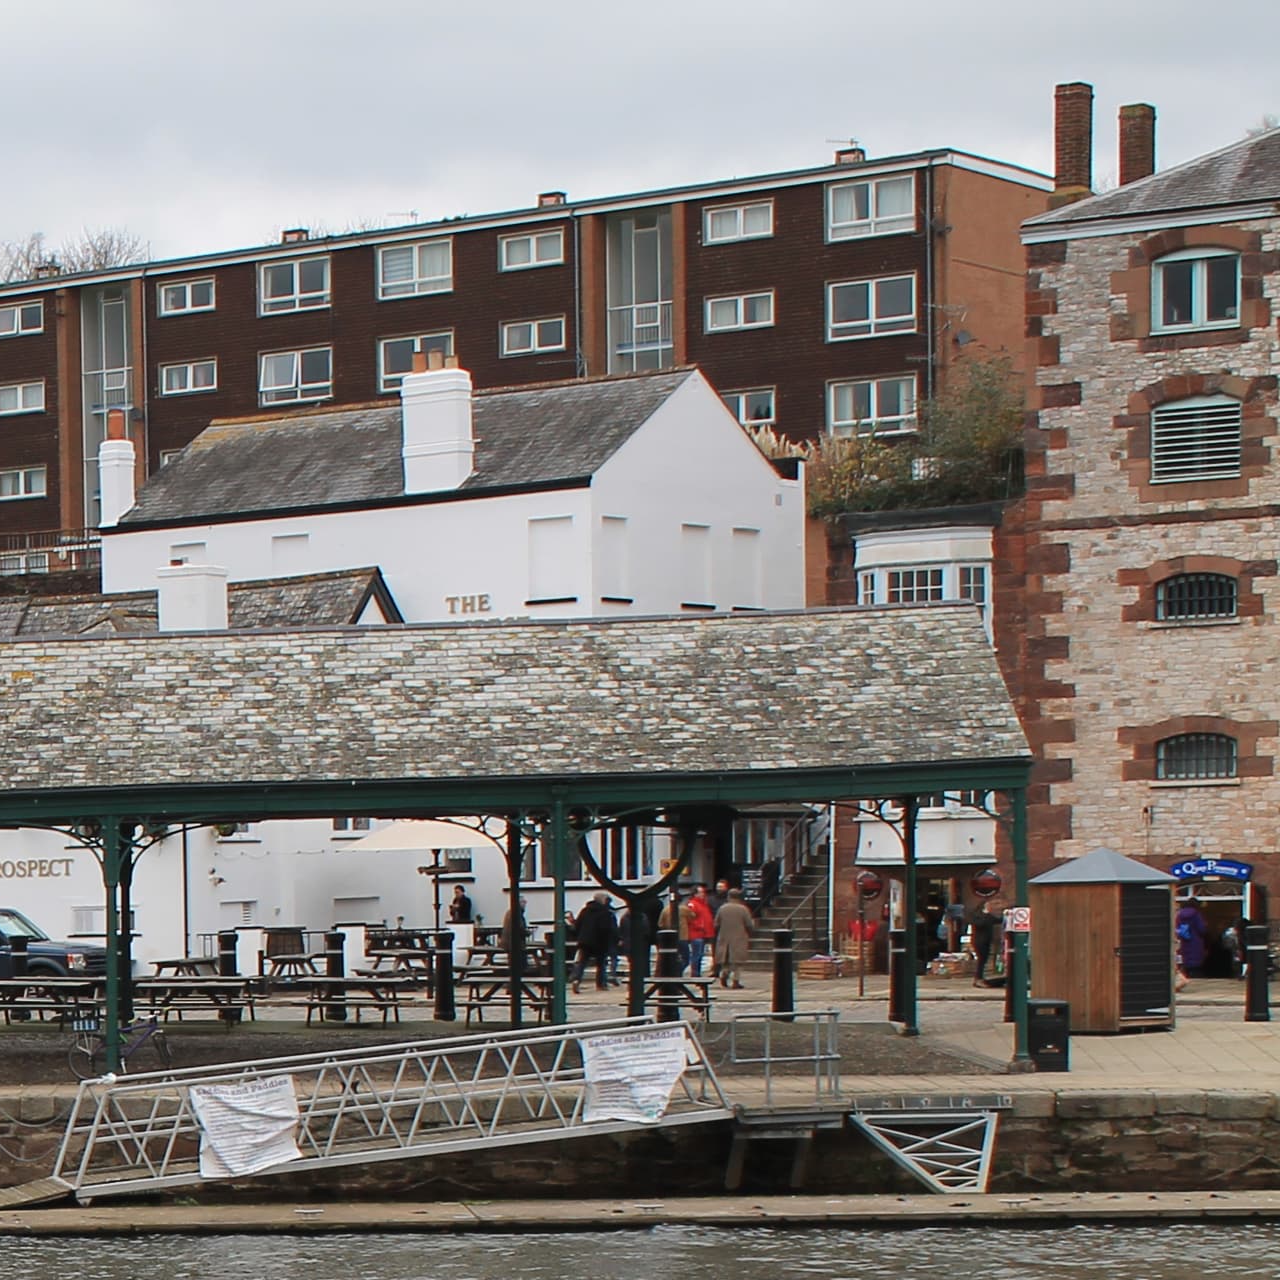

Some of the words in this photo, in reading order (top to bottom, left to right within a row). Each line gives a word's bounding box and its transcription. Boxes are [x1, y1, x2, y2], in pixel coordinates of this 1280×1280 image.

[445, 594, 491, 614] THE
[624, 1035, 641, 1043] and
[644, 1030, 681, 1041] Paddles
[251, 1079, 289, 1093] Paddles
